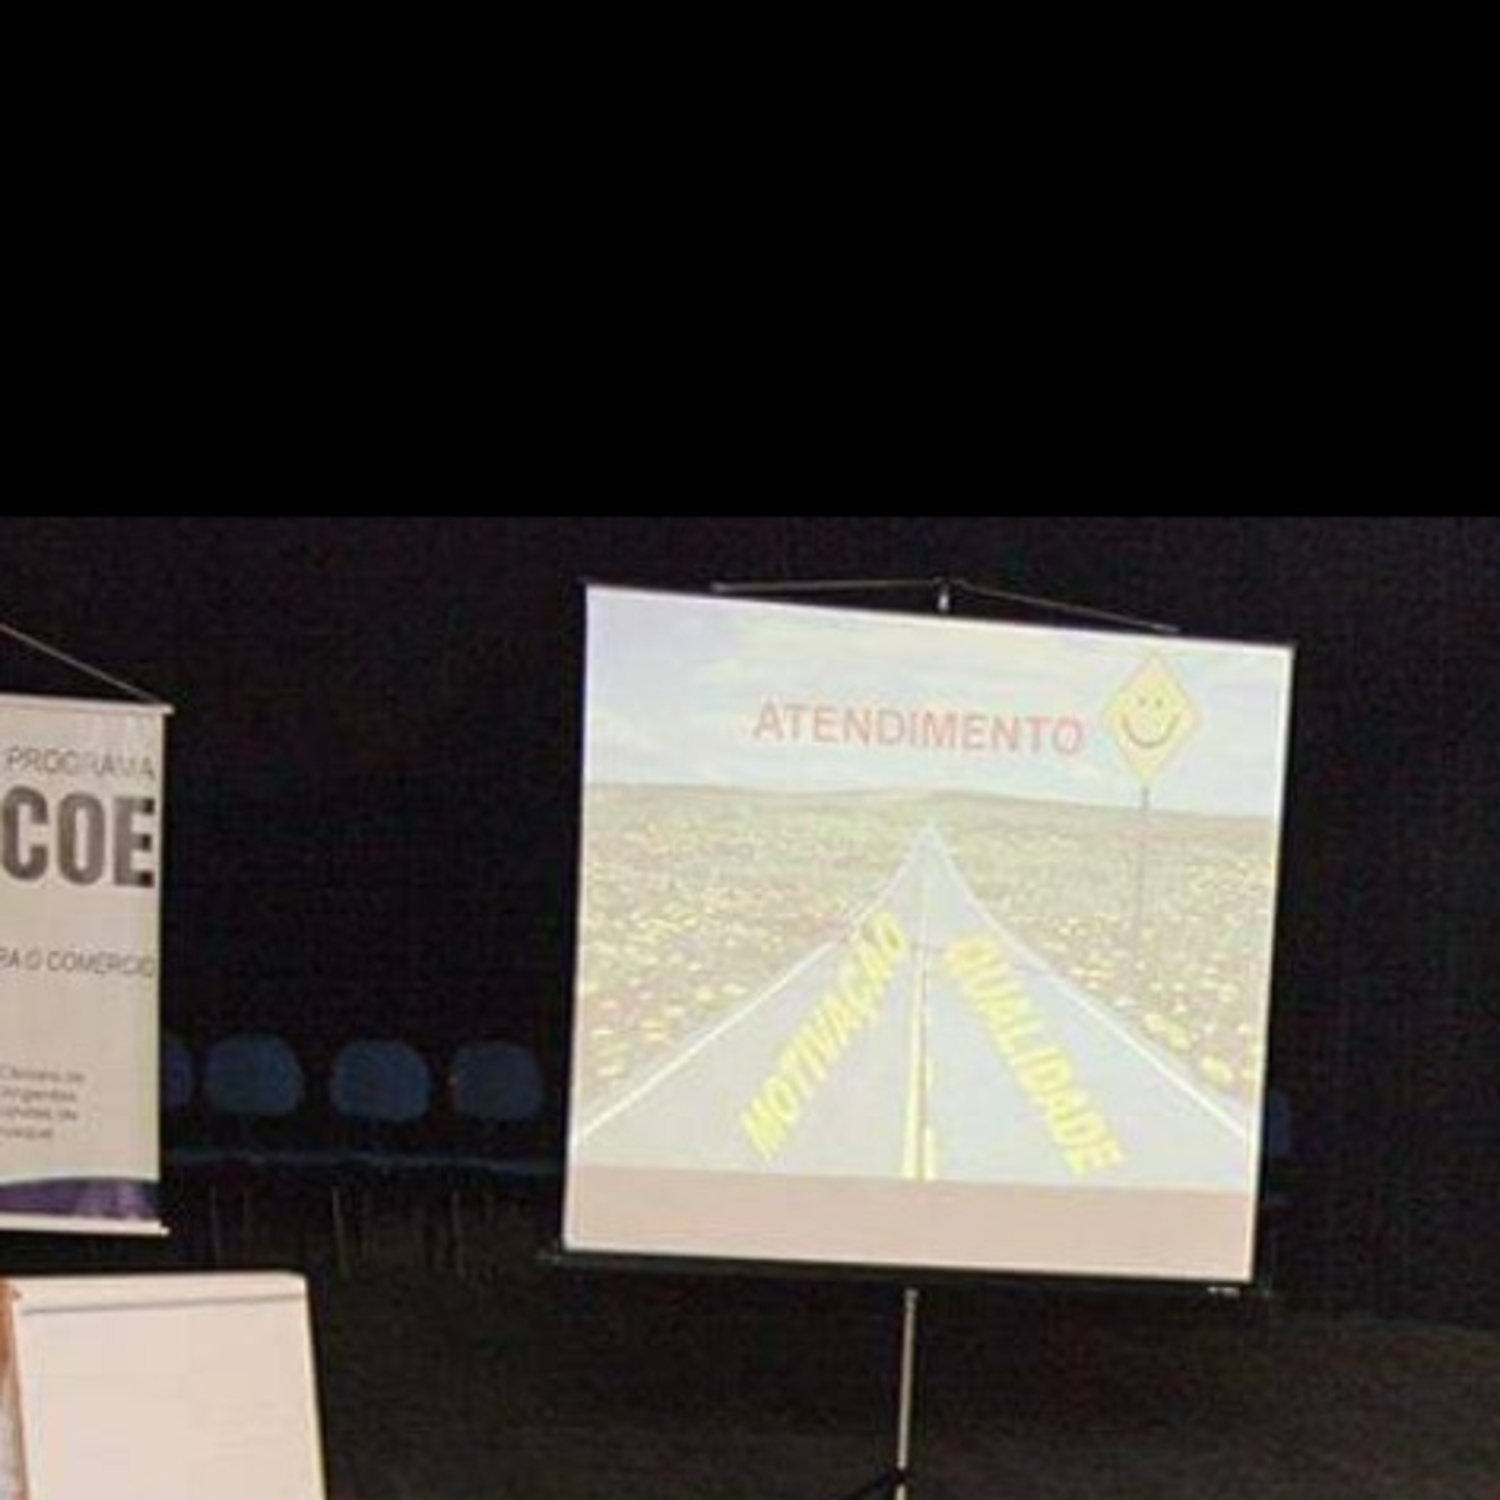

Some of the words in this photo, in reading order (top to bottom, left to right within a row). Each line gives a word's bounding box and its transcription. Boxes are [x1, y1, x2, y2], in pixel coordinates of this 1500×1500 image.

[6, 746, 156, 780] PROGRAMA
[752, 698, 1086, 759] ATENDIMENTO
[1, 785, 156, 889] COE
[742, 910, 910, 1162] MOTIVAÇÃO
[943, 933, 1126, 1178] QUALIDADE
